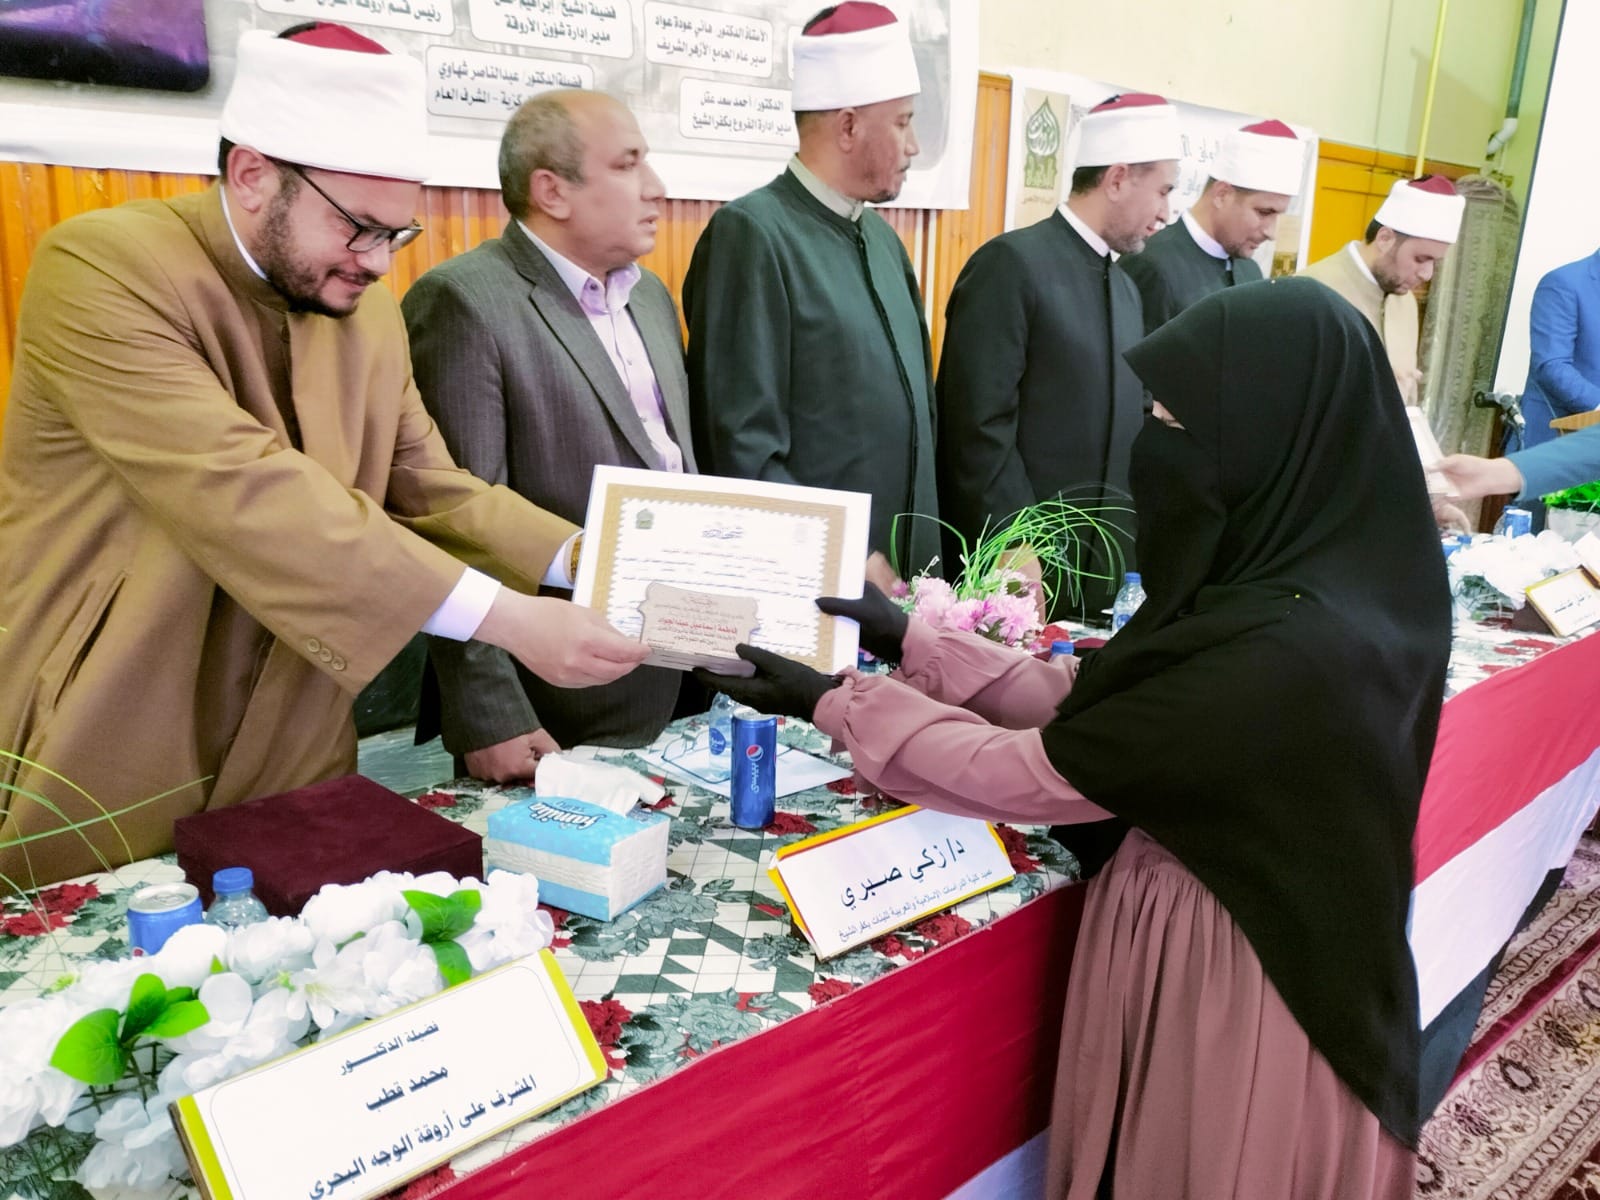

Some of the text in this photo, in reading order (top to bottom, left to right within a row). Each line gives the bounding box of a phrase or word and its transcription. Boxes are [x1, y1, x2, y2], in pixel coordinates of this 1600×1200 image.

[841, 866, 903, 911] صبري
[406, 1020, 440, 1044] فضيلة
[365, 1066, 449, 1113] محمد قطب
[490, 1073, 538, 1108] المشرف
[417, 1109, 455, 1143] أروقة
[458, 1100, 486, 1129] على
[371, 1132, 414, 1168] الوجه
